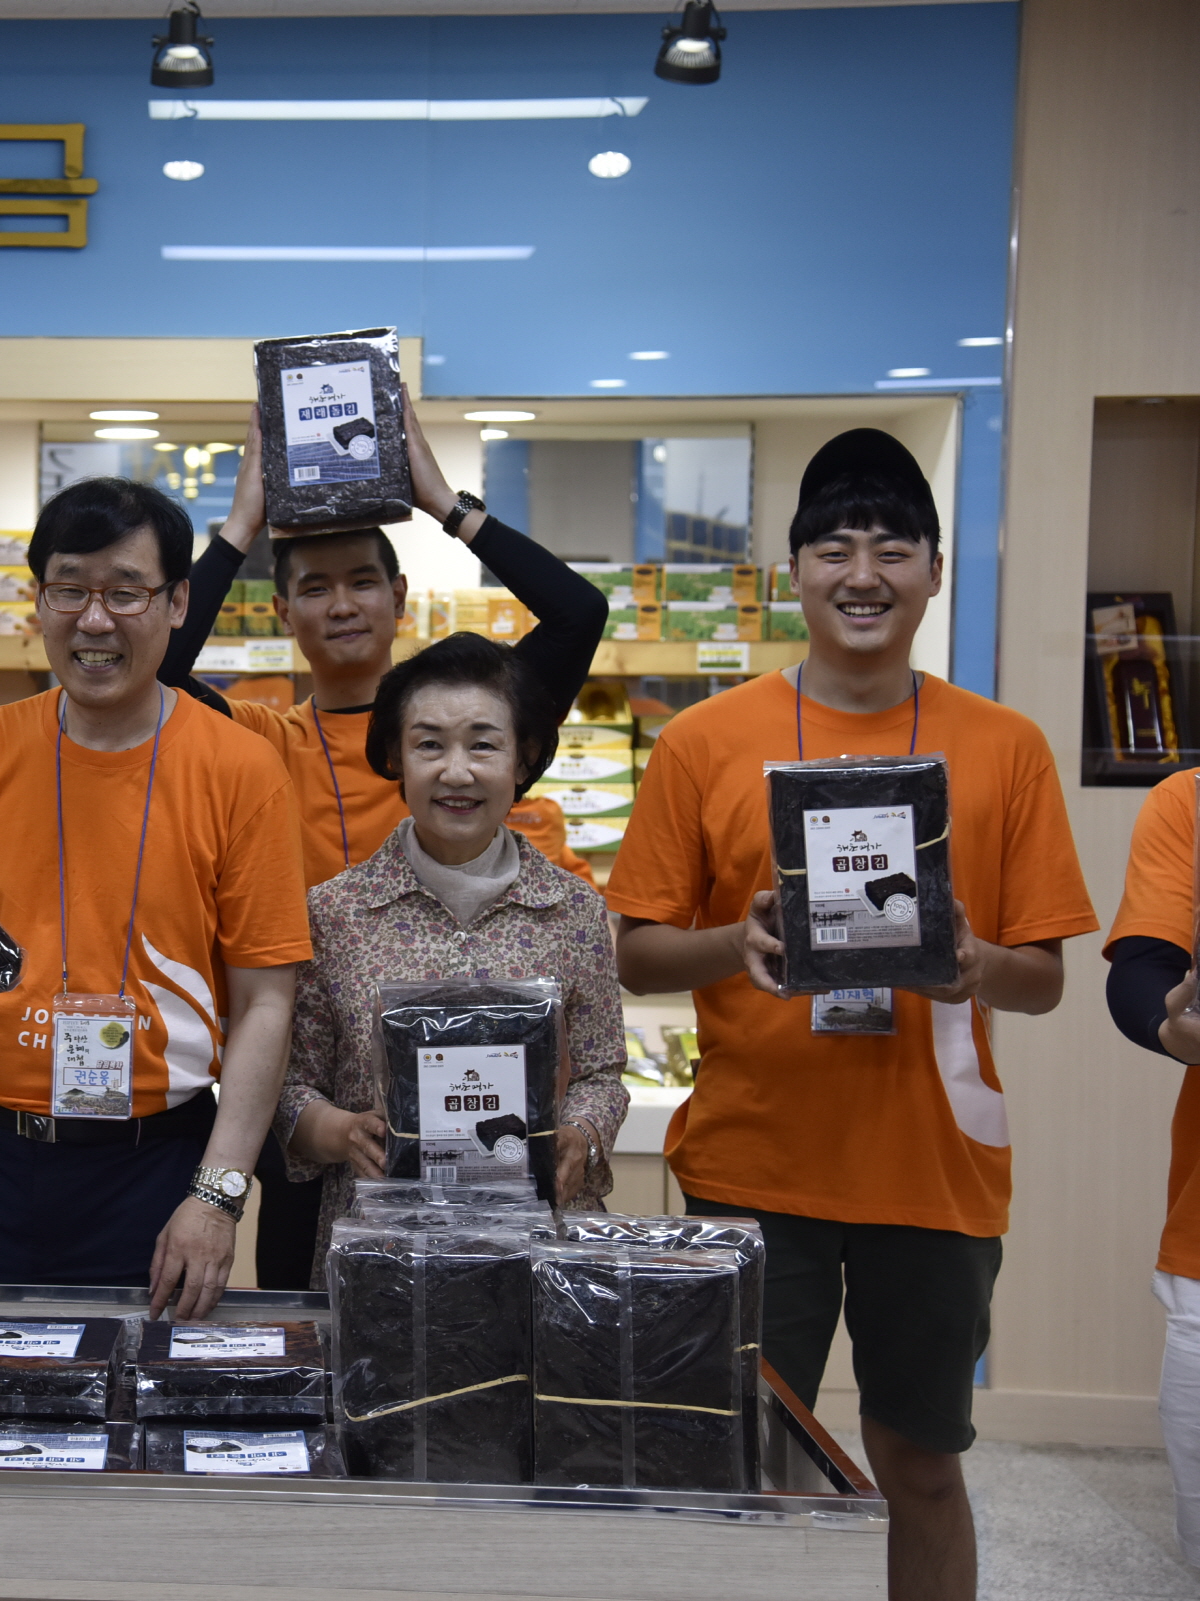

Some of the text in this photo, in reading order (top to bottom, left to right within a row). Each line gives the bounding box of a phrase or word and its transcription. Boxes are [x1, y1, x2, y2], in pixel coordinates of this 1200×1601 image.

[300, 403, 357, 420] 재래돌김
[833, 856, 888, 872] 곱창김
[446, 1096, 500, 1111] 곱창김
